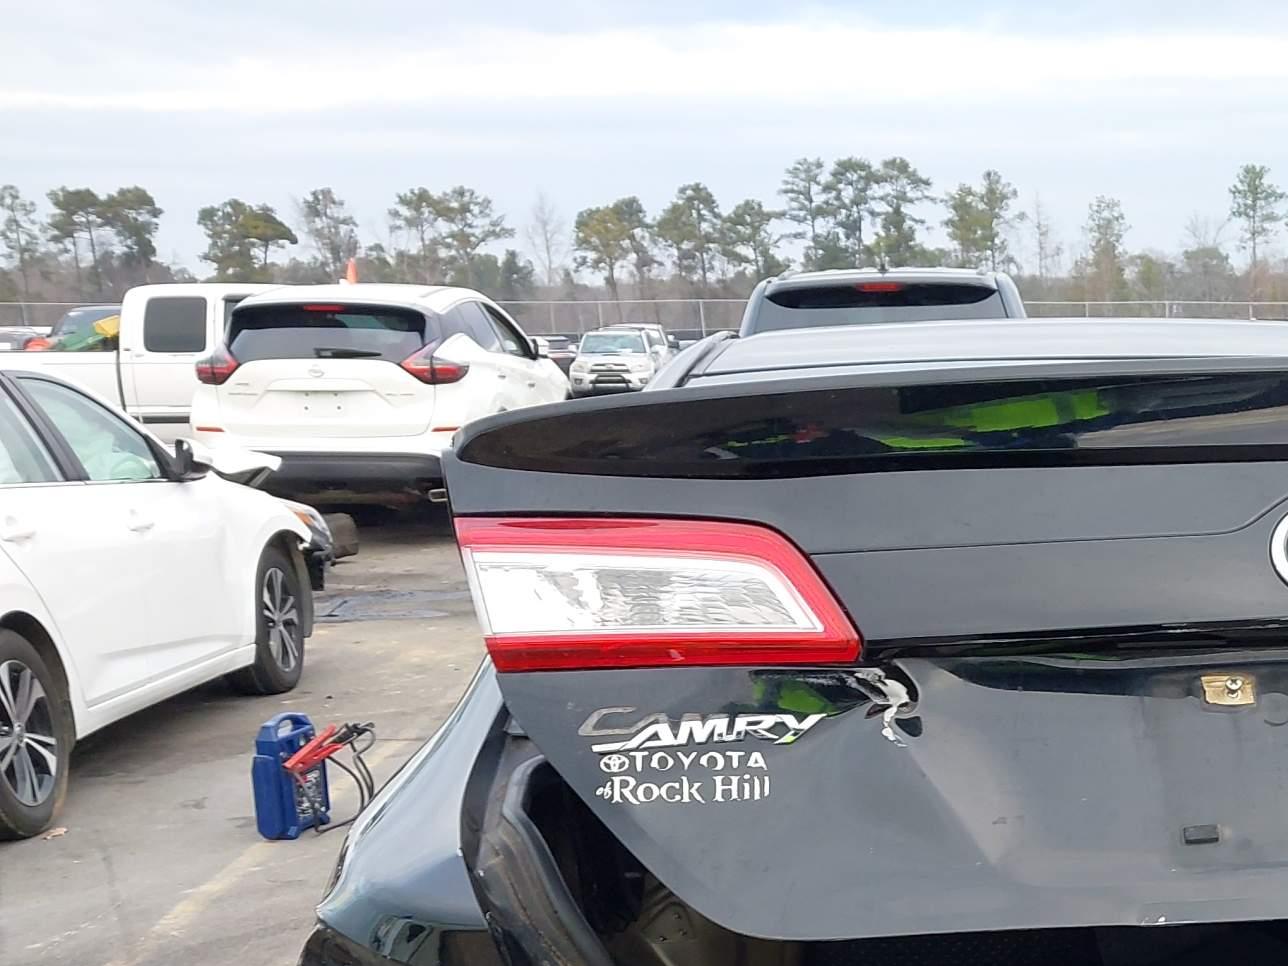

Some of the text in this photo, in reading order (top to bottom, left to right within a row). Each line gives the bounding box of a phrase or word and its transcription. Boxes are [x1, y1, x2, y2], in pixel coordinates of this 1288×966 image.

[578, 706, 828, 753] CAMRY
[630, 751, 768, 773] TOYOTA
[596, 773, 770, 805] of Rock Hill
